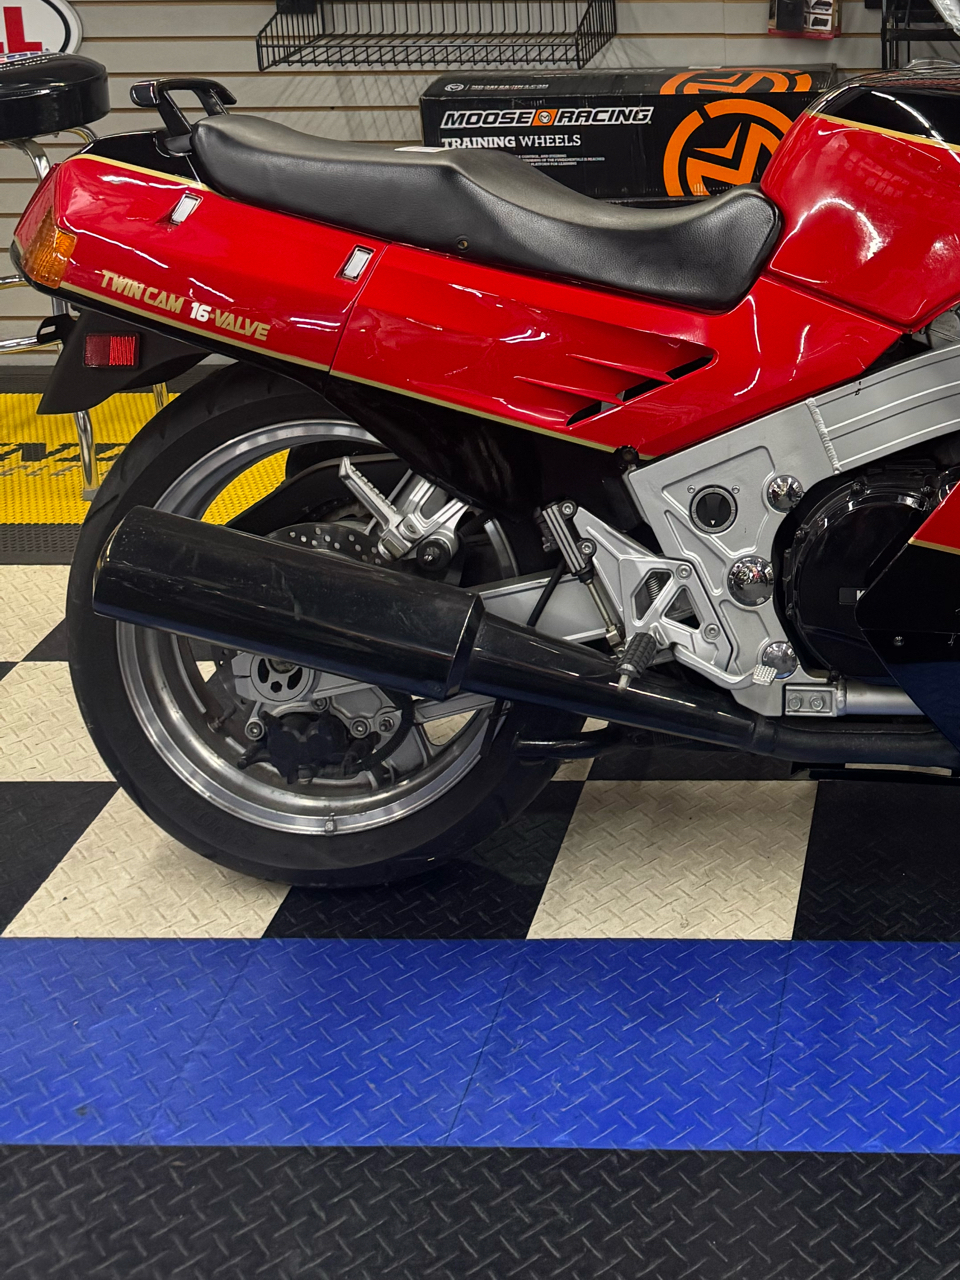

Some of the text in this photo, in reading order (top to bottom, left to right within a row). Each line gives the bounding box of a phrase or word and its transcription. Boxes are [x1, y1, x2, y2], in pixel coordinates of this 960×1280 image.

[440, 107, 654, 128] MOOSE RACING
[441, 134, 581, 149] TRAINING WHEELS
[101, 268, 271, 341] TWIN CAM 16-VALVE
